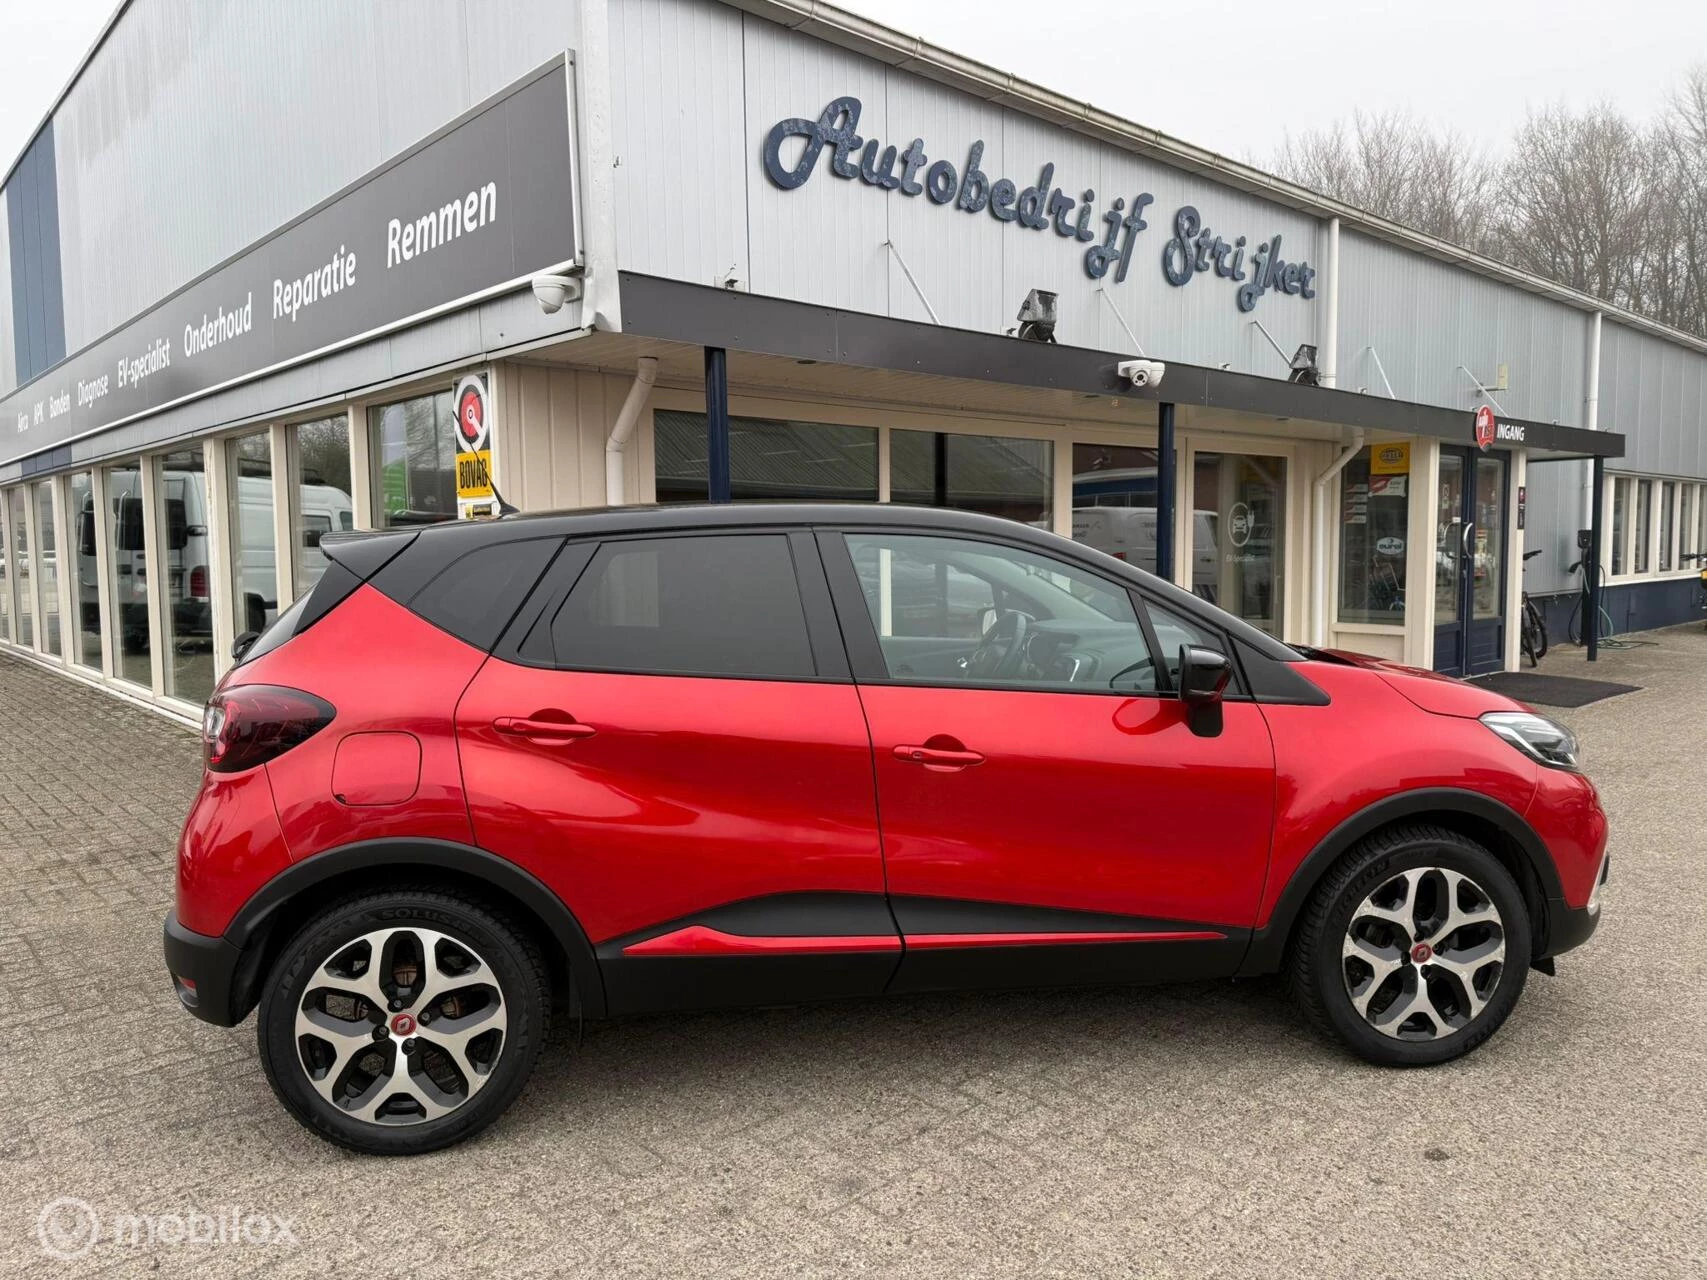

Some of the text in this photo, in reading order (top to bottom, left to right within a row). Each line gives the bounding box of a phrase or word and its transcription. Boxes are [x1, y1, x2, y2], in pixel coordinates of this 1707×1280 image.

[763, 96, 1316, 312] Autobedrijf Strijker
[34, 400, 45, 426] APK
[50, 390, 70, 418] Banden
[78, 374, 109, 408] Diagnose
[118, 337, 170, 389] EV-specialist
[184, 292, 252, 357] Onderhoud
[273, 245, 356, 322] Reparatie
[387, 181, 497, 268] Remmen
[460, 459, 488, 489] BOVAG
[1496, 423, 1525, 442] INGANG
